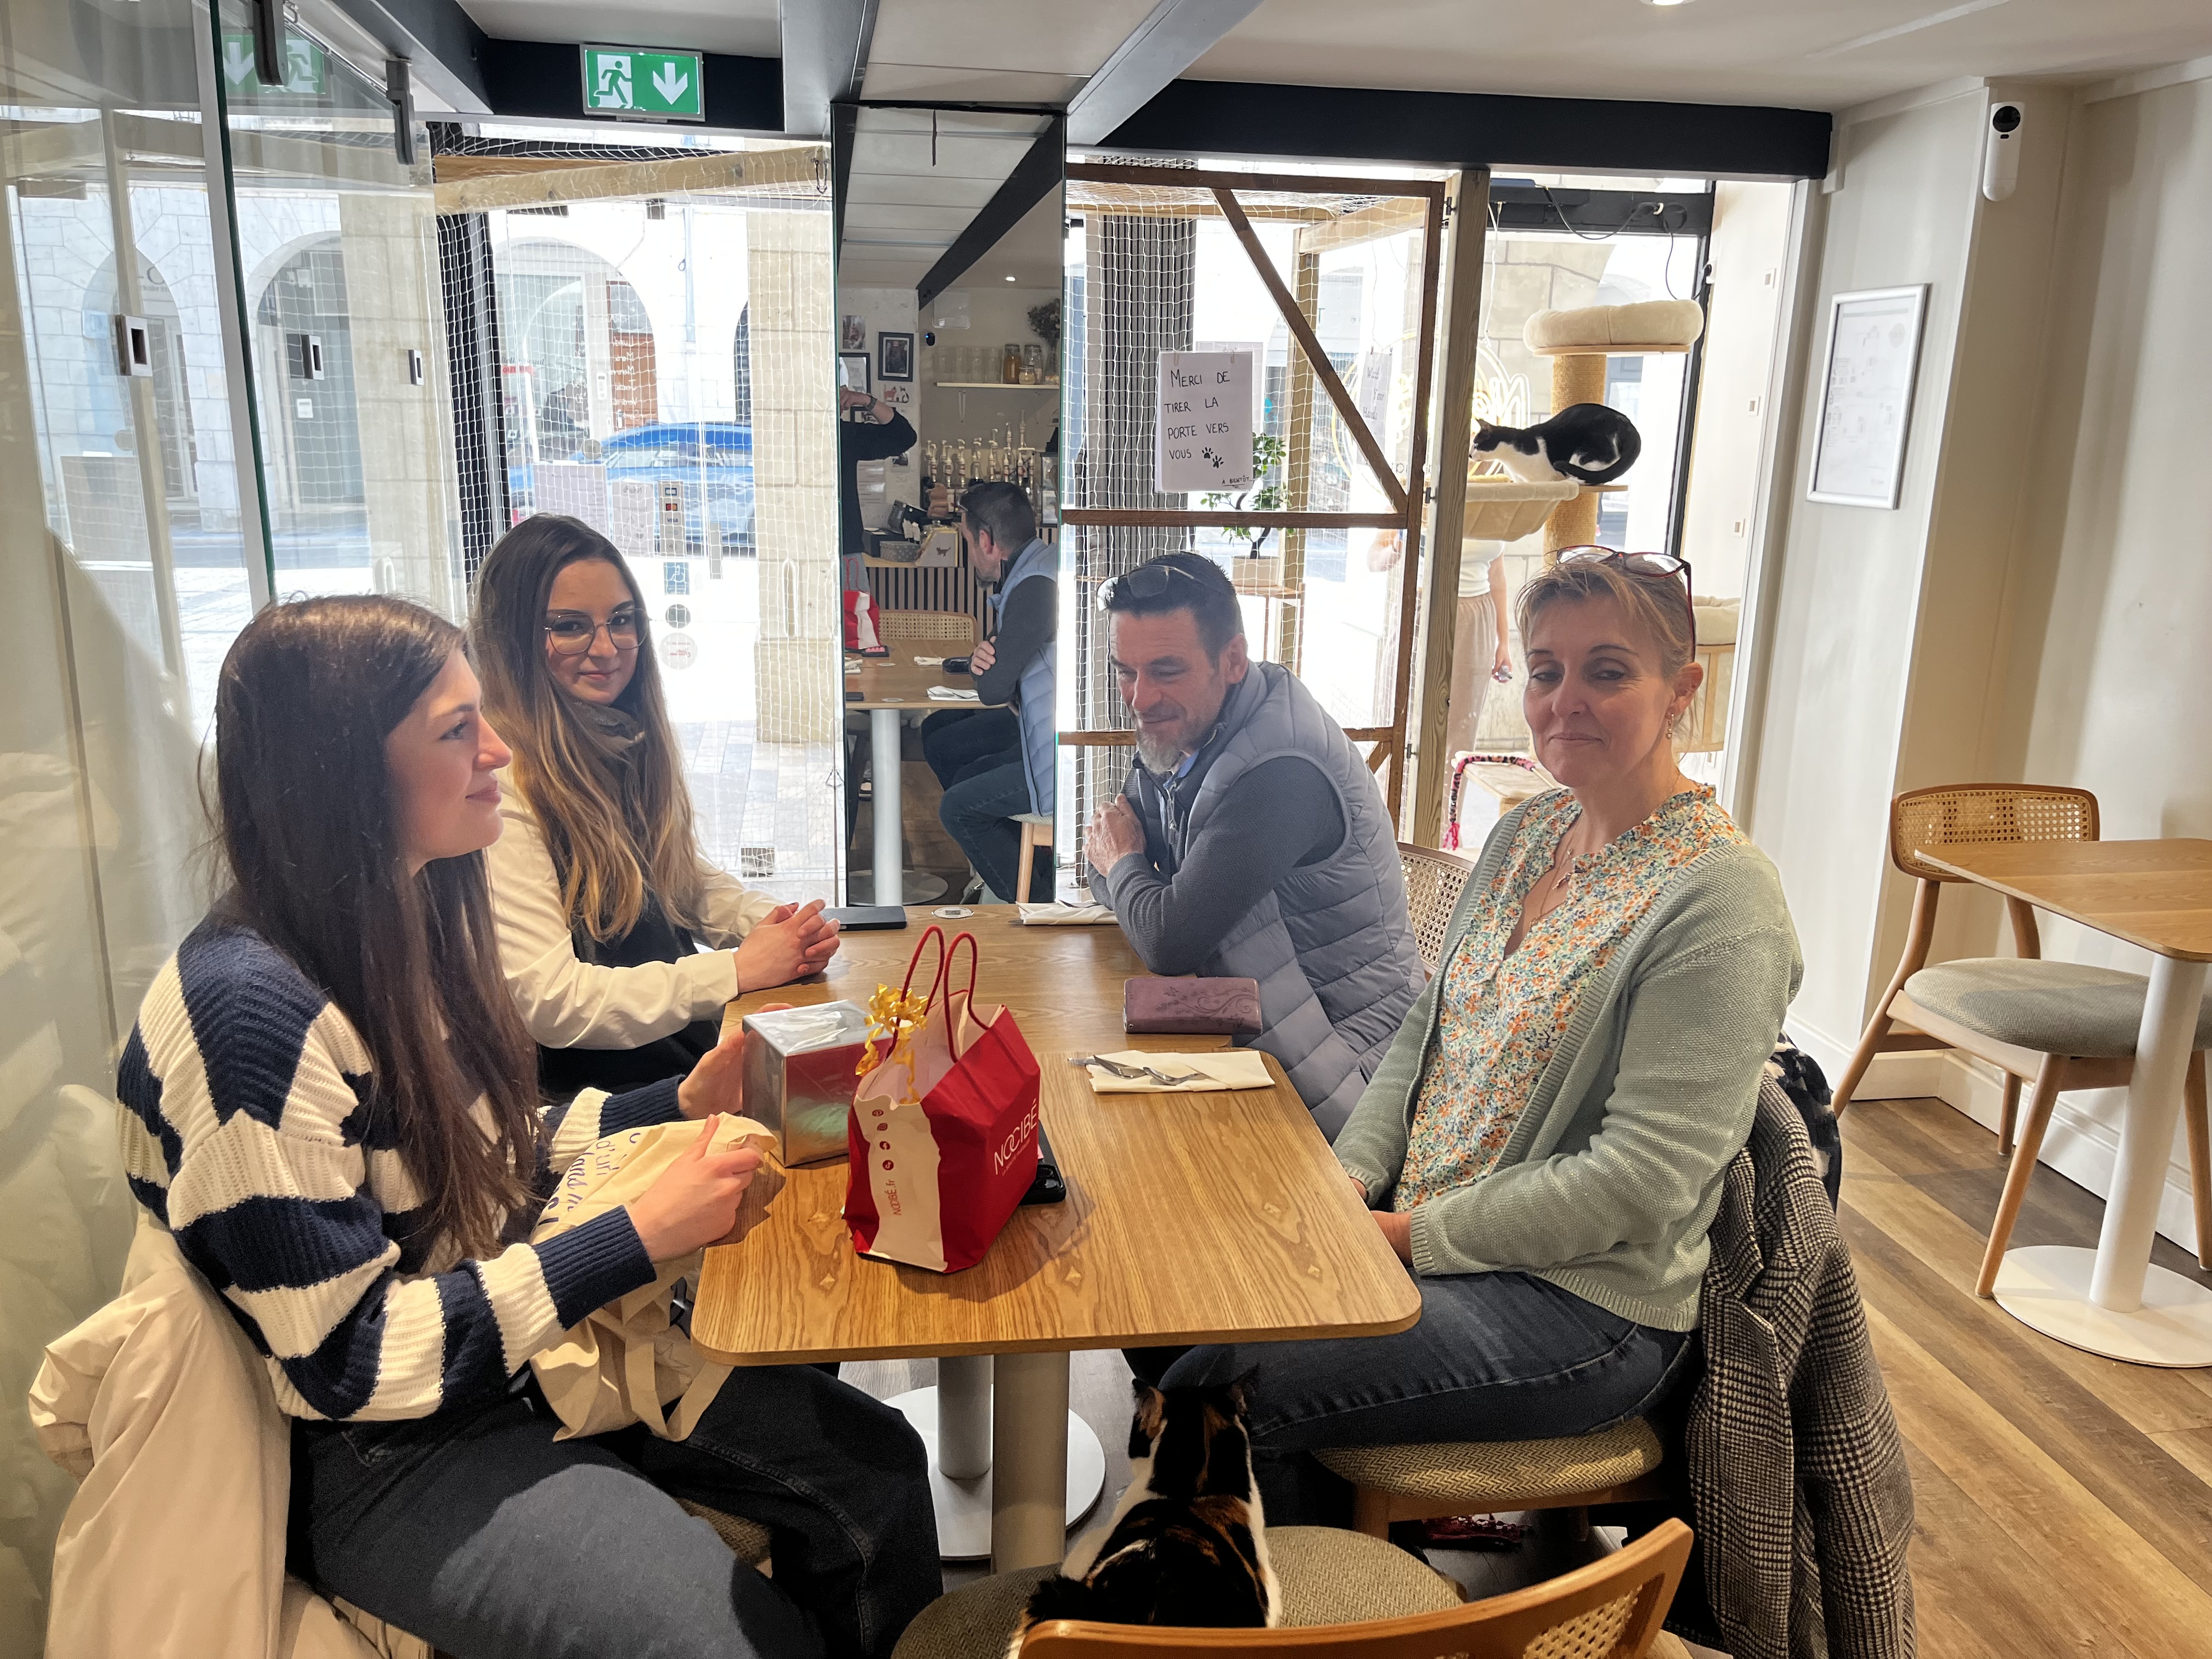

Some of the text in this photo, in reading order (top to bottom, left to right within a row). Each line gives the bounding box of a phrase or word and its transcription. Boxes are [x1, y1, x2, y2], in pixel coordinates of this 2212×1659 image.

[1170, 369, 1231, 387] MERCI DE
[1164, 397, 1219, 413] TIRER LA
[1167, 422, 1229, 439] PORTE VERS
[1169, 449, 1192, 459] VOUS
[994, 1098, 1037, 1175] NOCIBÉ
